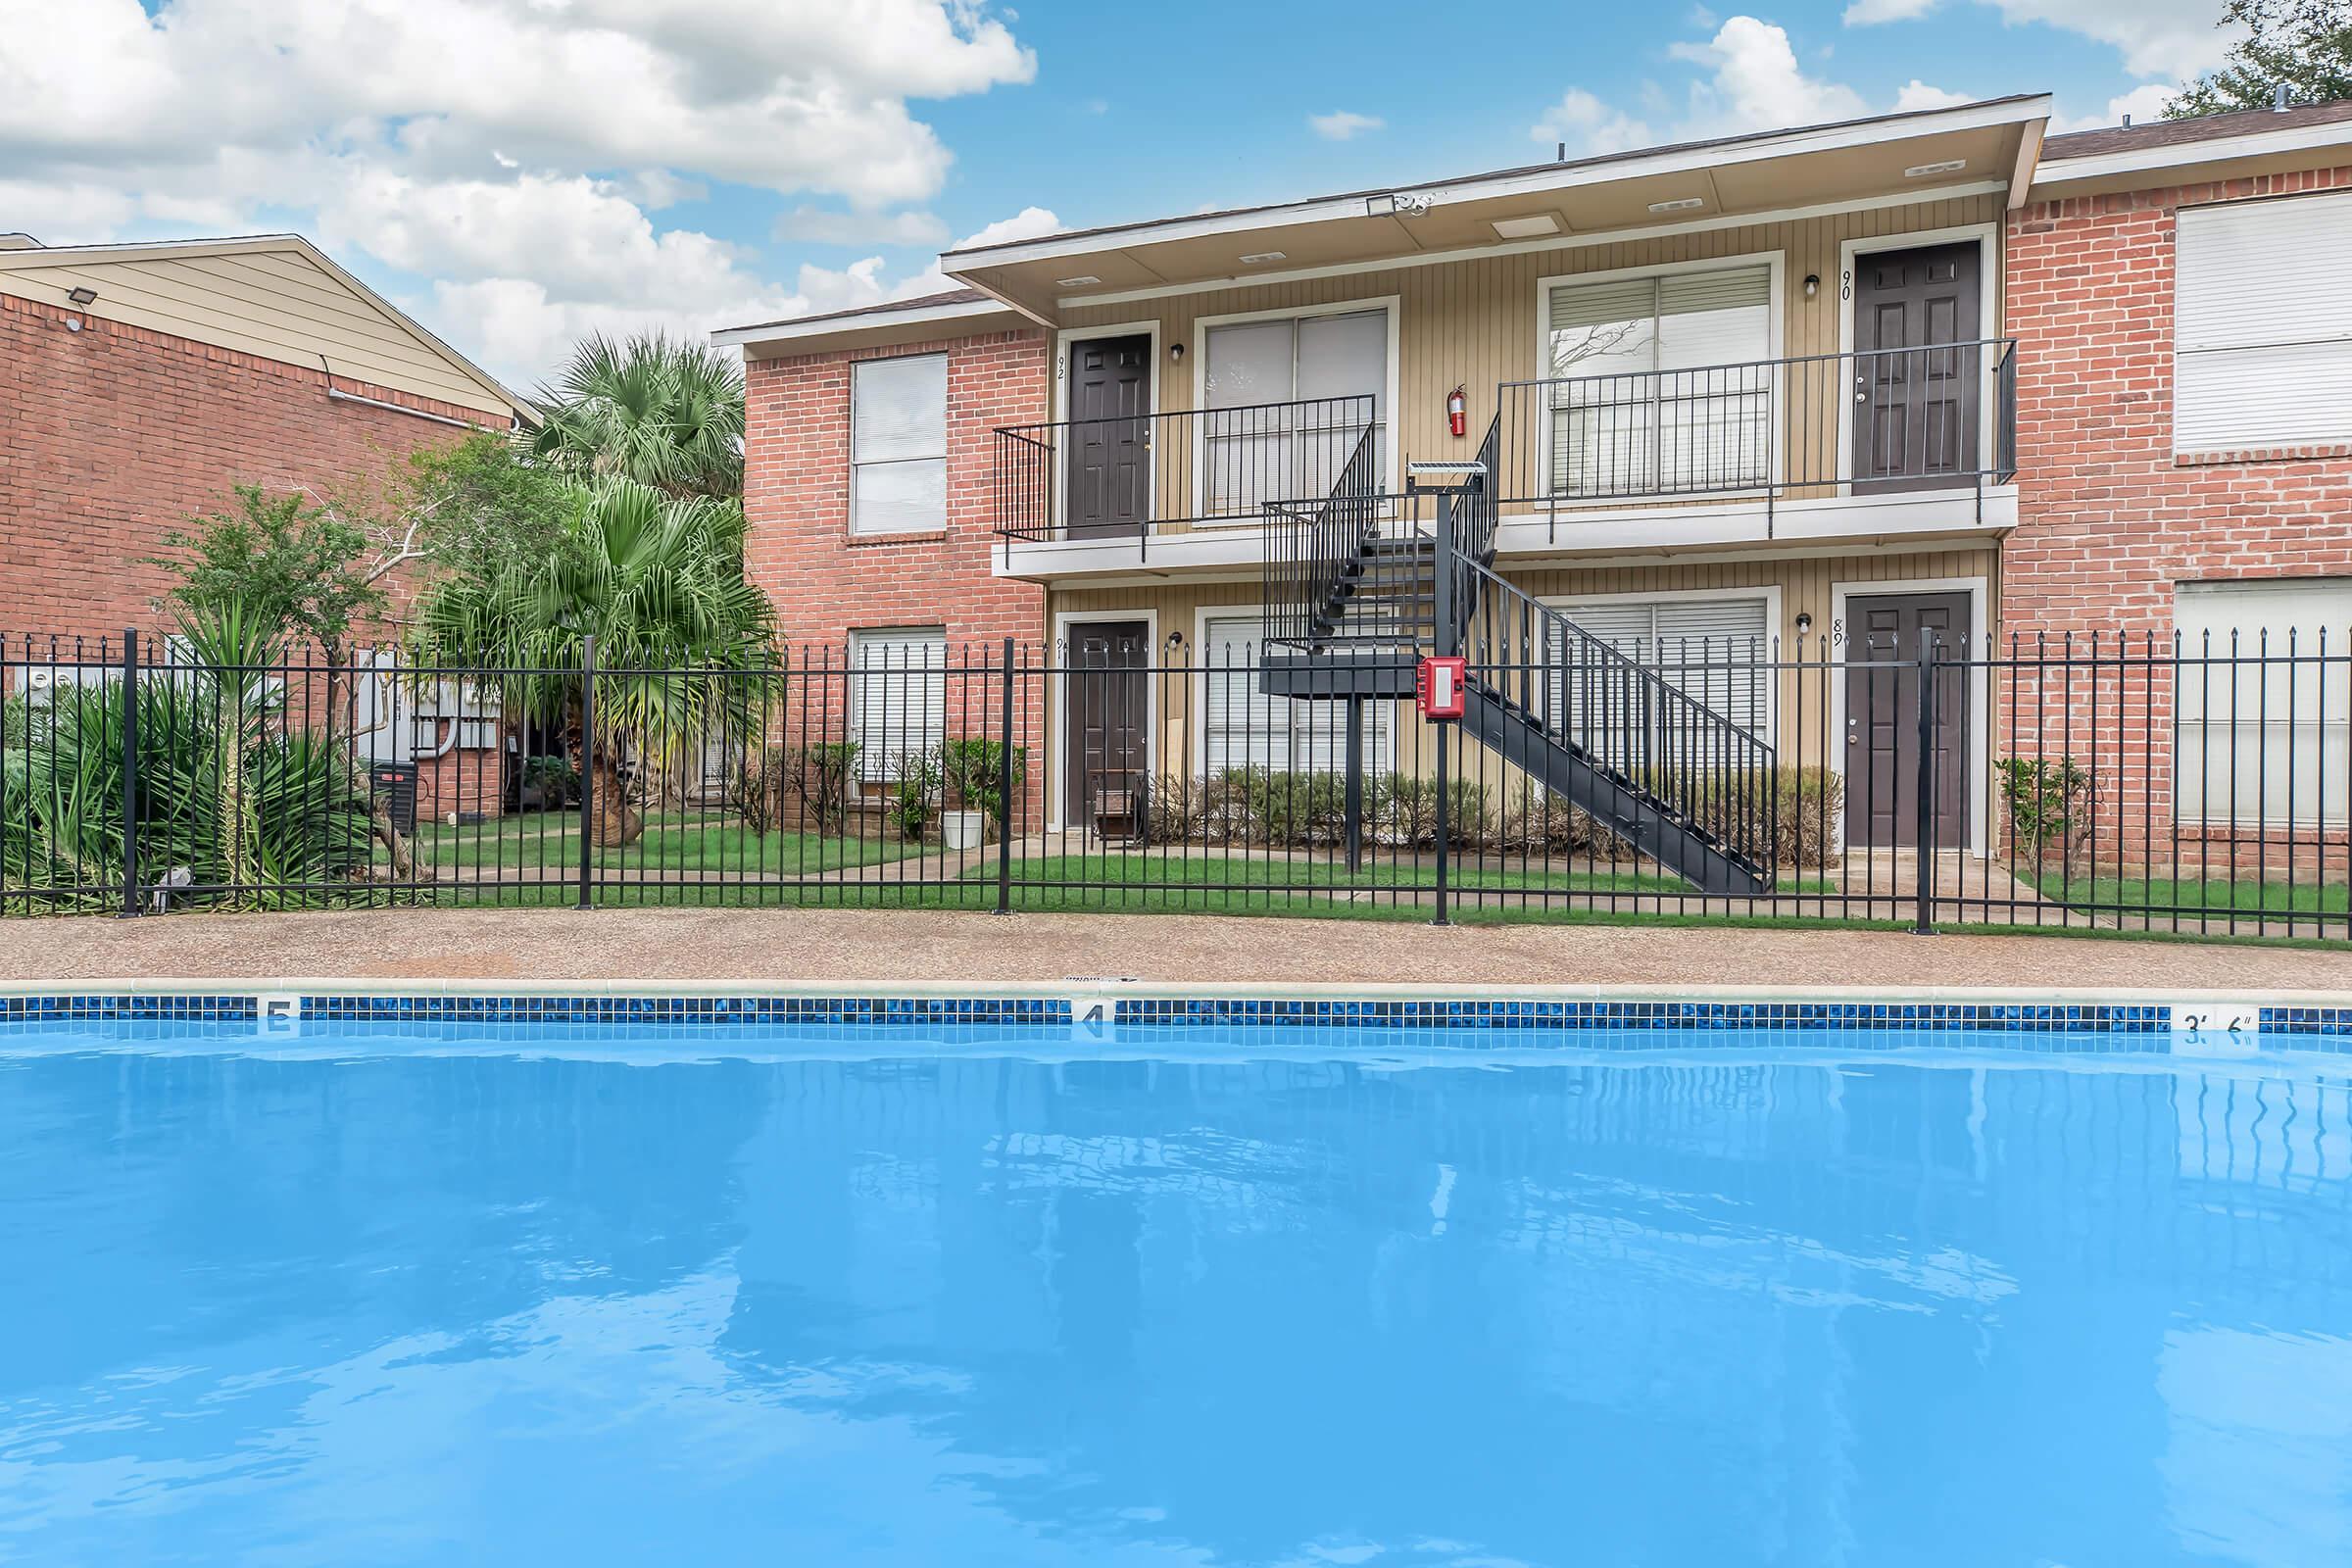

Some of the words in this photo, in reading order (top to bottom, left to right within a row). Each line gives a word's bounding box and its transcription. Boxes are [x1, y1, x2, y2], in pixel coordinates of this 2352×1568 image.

[1842, 270, 1850, 301] 90
[1058, 356, 1064, 379] 92
[1834, 618, 1843, 647] 89
